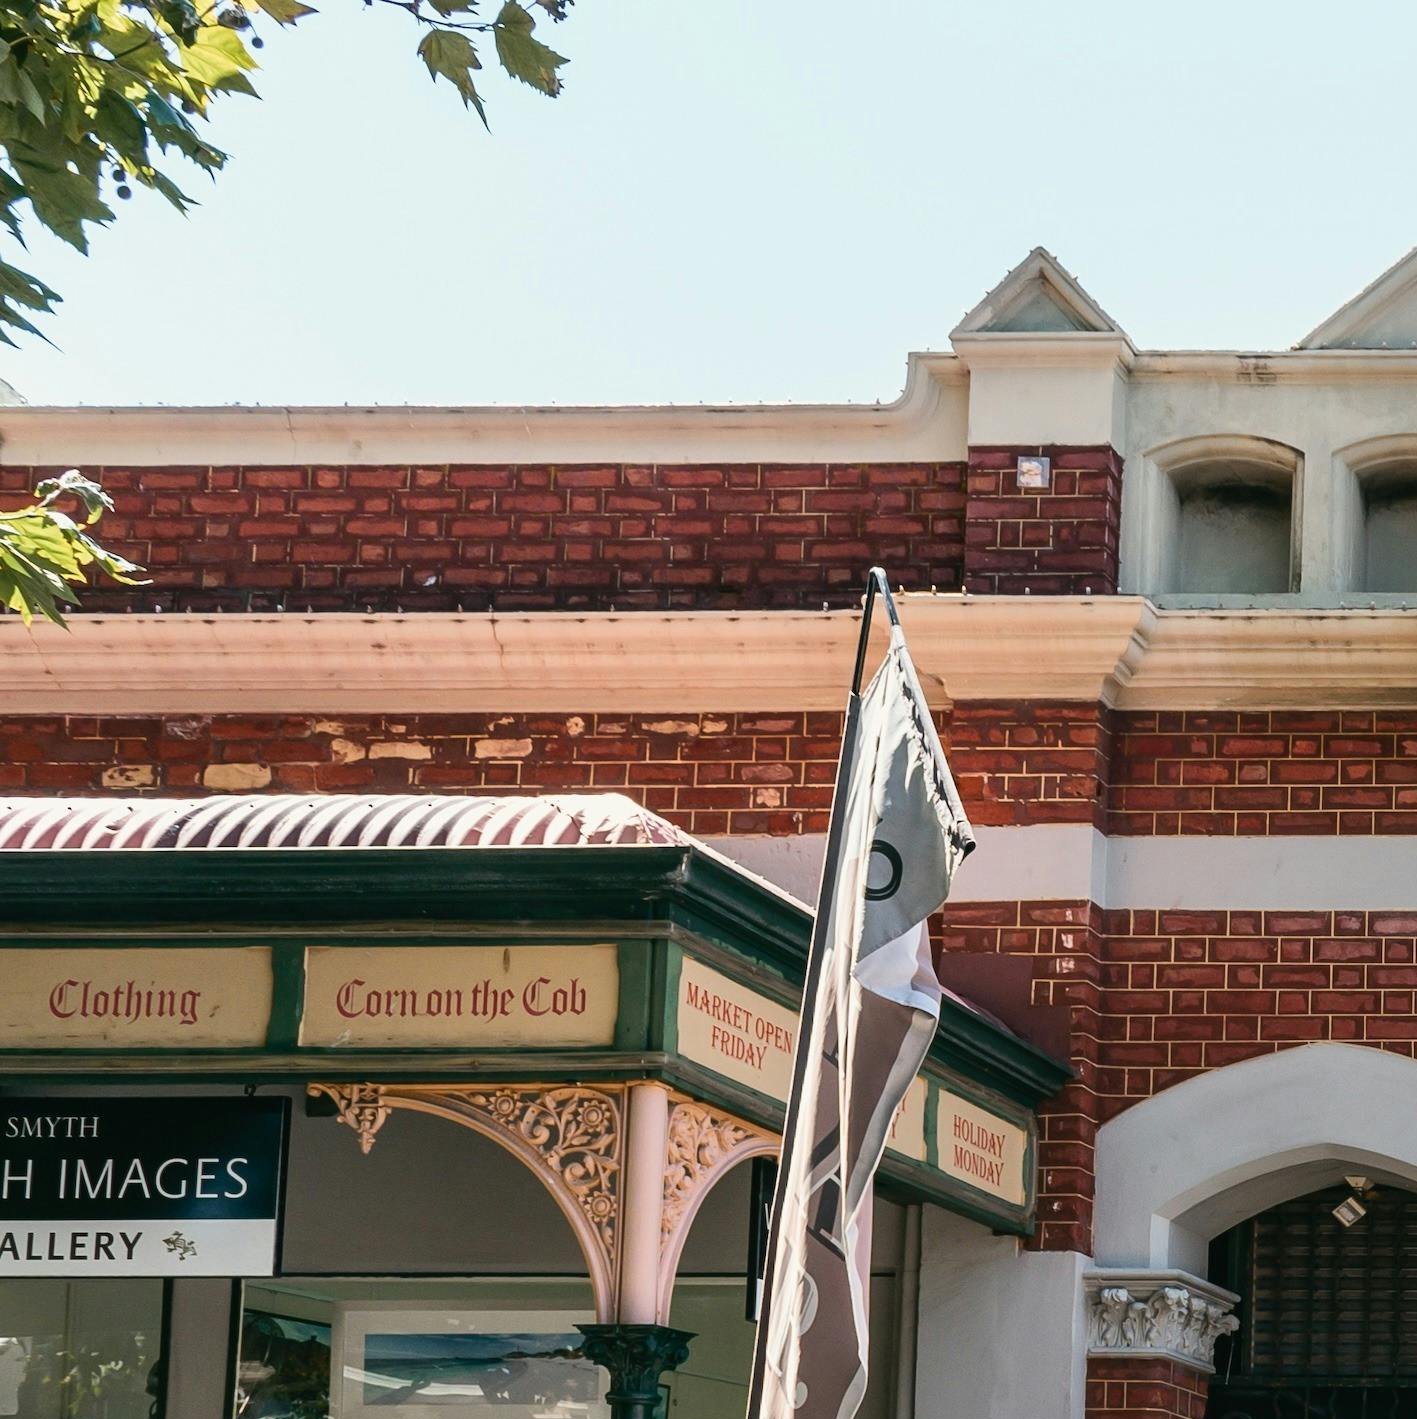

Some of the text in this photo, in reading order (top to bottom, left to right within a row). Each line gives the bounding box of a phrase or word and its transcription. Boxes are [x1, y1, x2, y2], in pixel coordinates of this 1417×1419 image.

[49, 979, 202, 1026] Clothing
[336, 977, 588, 1022] Corn on the Cob
[685, 981, 793, 1052] MARKET OPEN
[711, 1024, 768, 1071] FRIDAY
[5, 1116, 99, 1139] SMYTH
[953, 1113, 1007, 1159] HOLIDAY
[59, 1158, 249, 1200] IMAGES
[953, 1153, 1005, 1187] MONDAY
[0, 1231, 144, 1261] ALLERY
